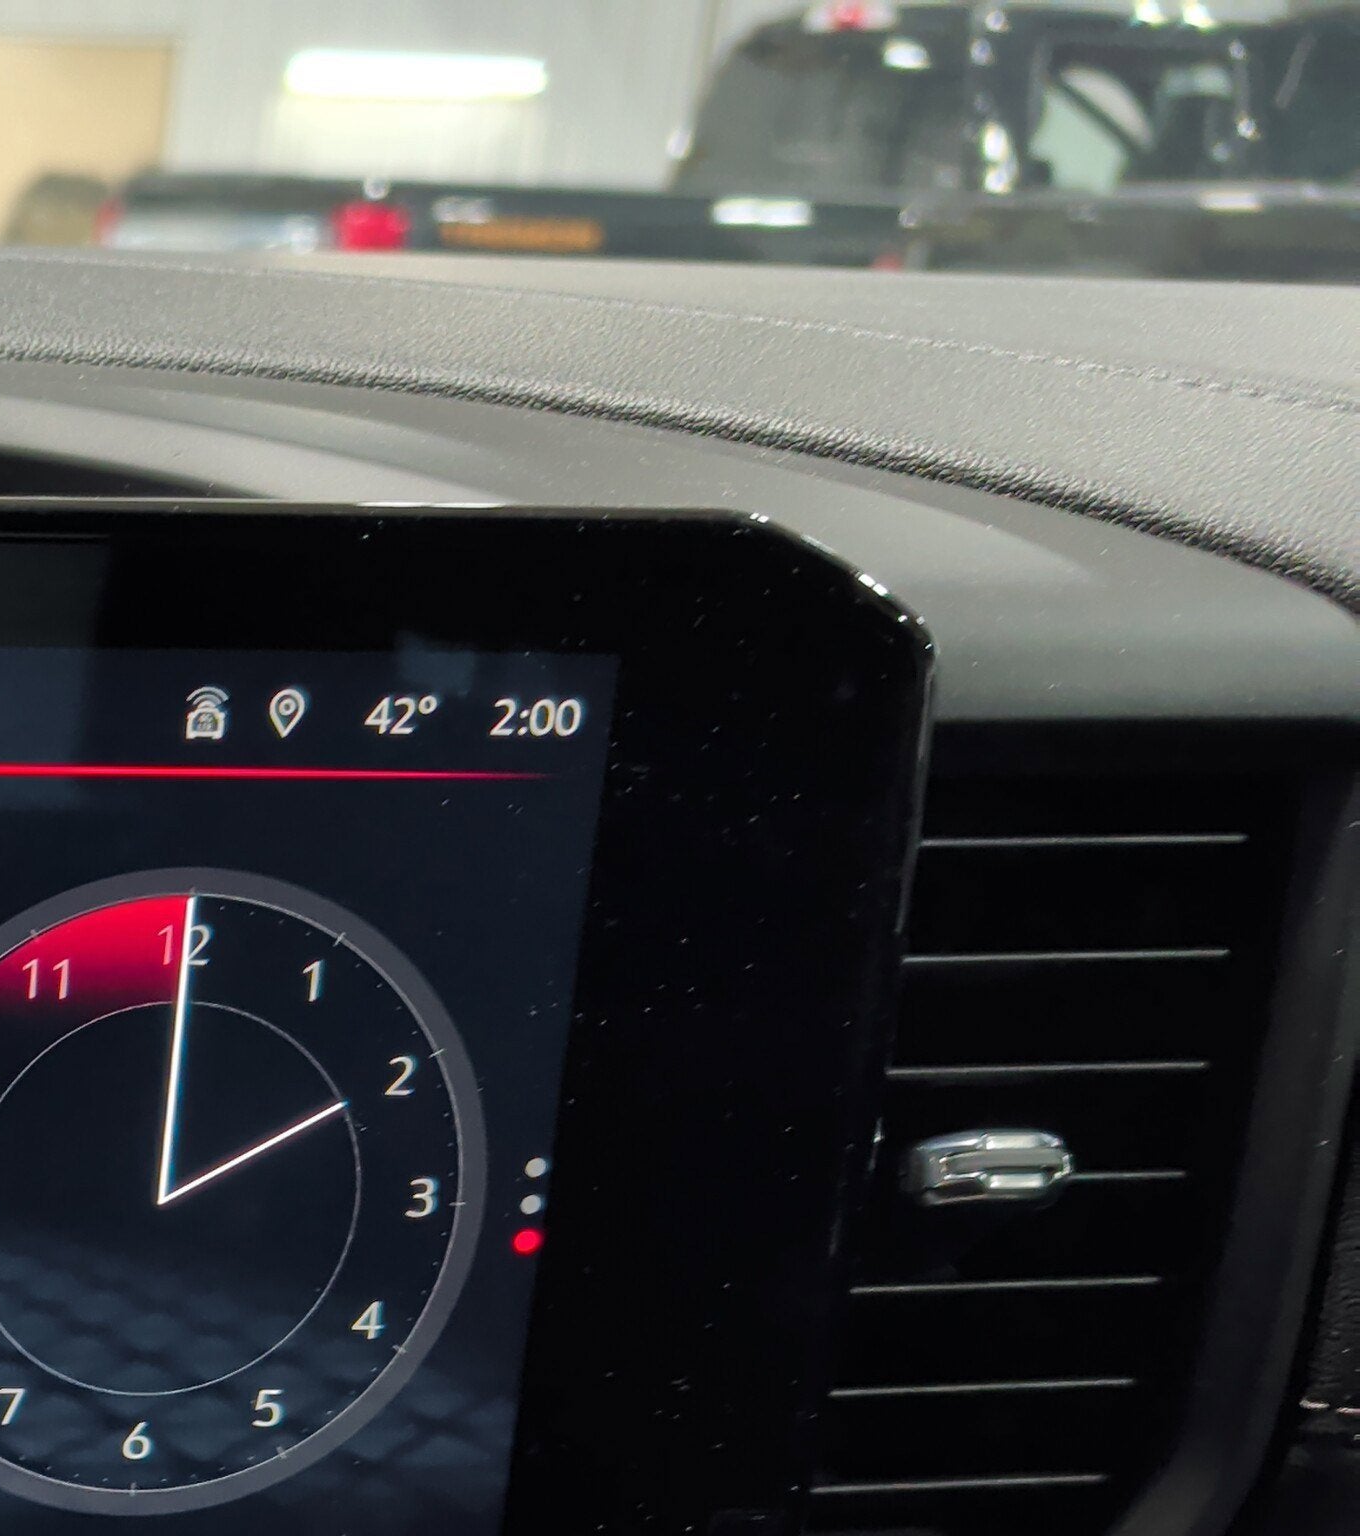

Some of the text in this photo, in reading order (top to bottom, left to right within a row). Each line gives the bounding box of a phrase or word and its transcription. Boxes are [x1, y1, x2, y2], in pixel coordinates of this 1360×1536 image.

[490, 698, 582, 737] 2:00
[157, 924, 211, 966] 12
[21, 958, 71, 1001] 11
[302, 960, 326, 1002] 1
[384, 1056, 417, 1096] 2
[404, 1177, 438, 1218] 3
[351, 1300, 385, 1340] 4
[252, 1389, 283, 1427] 5
[122, 1421, 152, 1460] 6
